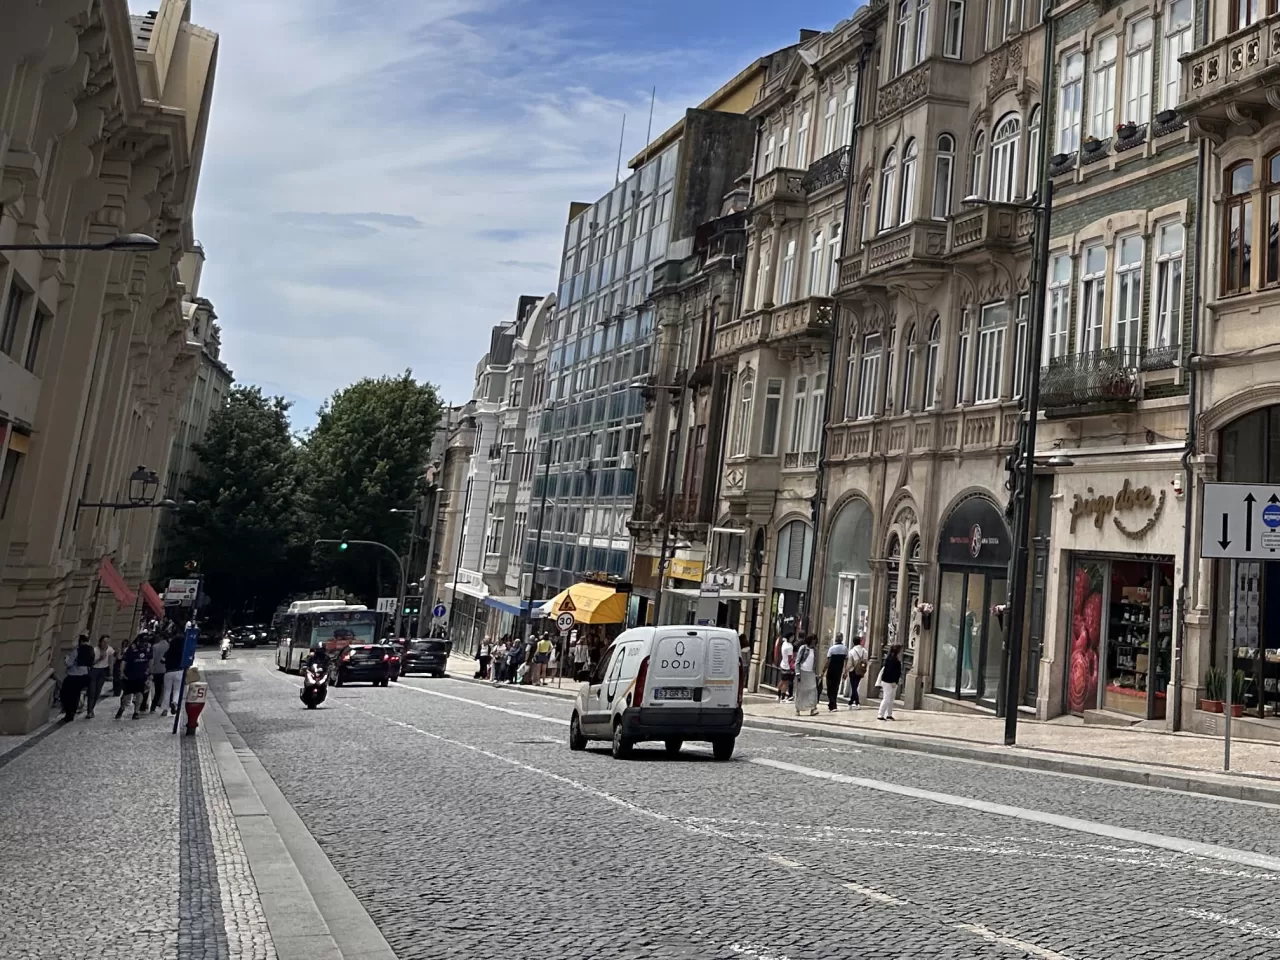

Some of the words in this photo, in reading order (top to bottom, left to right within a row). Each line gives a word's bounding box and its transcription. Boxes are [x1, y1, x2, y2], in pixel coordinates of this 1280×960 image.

[1069, 486, 1115, 534] pingo
[1114, 478, 1156, 511] doce
[559, 617, 572, 626] 30
[661, 659, 696, 670] DODI
